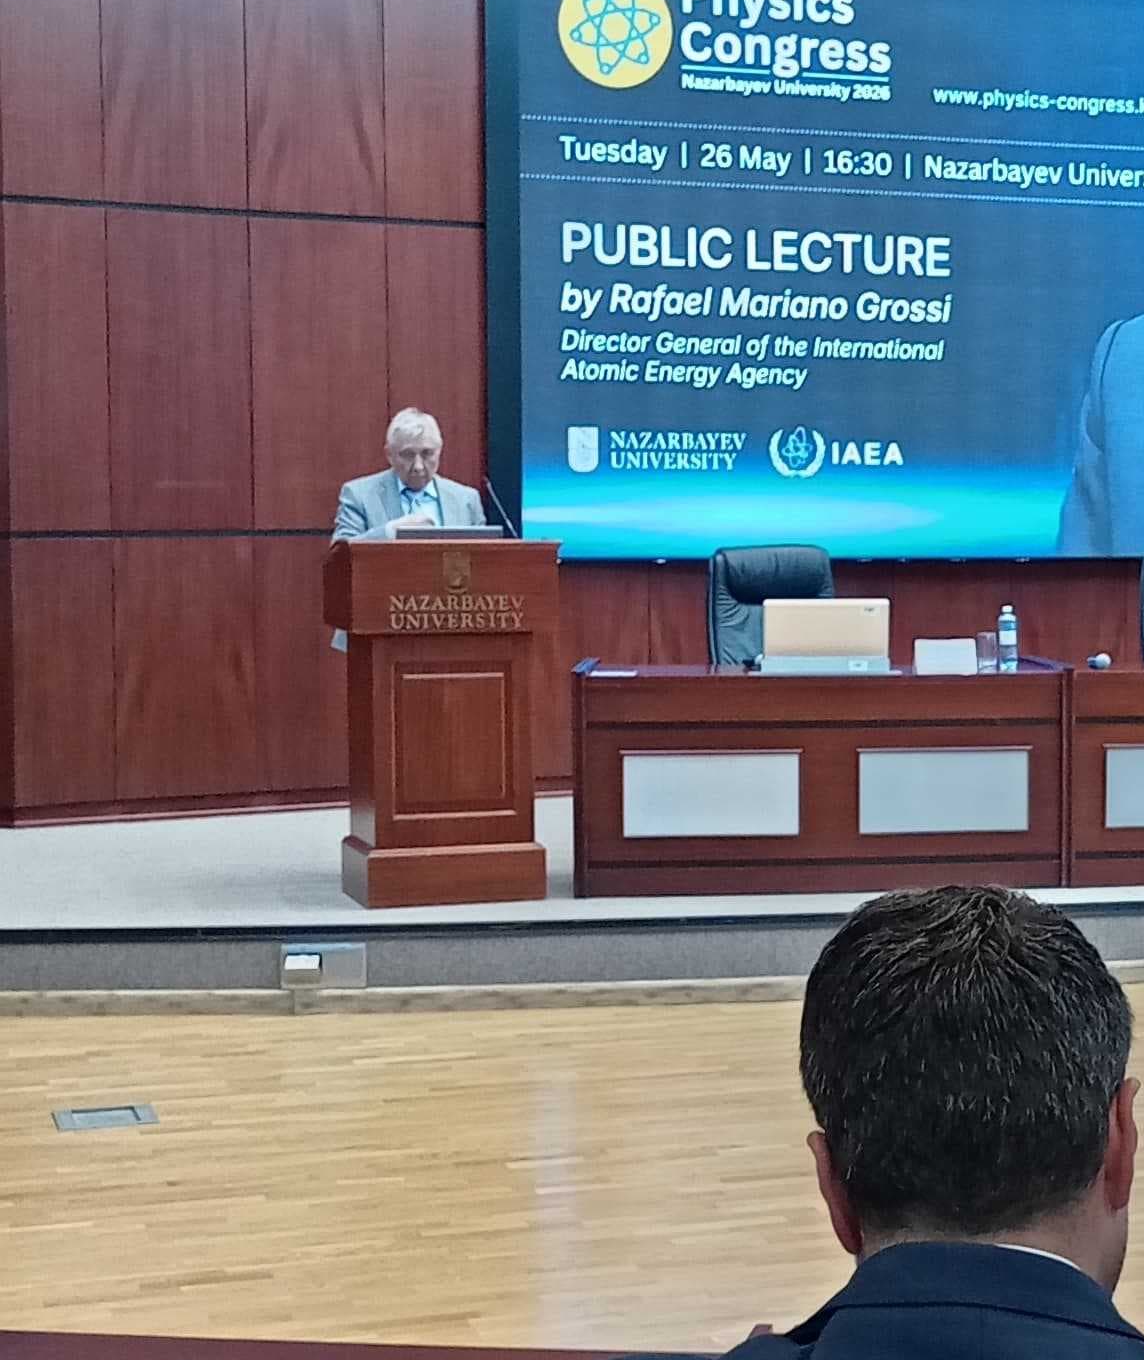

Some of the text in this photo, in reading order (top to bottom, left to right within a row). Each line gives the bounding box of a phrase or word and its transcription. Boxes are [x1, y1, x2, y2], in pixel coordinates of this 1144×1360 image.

[680, 21, 892, 78] Congress
[681, 73, 892, 101] Nazarbayev University 2026
[559, 136, 668, 171] Tuesday
[700, 143, 733, 168] 26
[739, 145, 792, 176] May
[823, 149, 893, 176] 16:30
[924, 154, 1062, 189] Nazarbayev
[562, 221, 951, 277] PUBLIC LECTURE
[561, 281, 952, 324] by Rafael Mariano Grossi
[561, 329, 944, 361] Director General of the International
[561, 358, 807, 390] Atomic Energy Agency
[610, 430, 746, 450] NAZARBAYEV
[831, 441, 904, 466] IAEA
[610, 451, 737, 471] UNIVERSITY
[389, 595, 525, 612] NAZARBAYEV
[391, 612, 524, 630] UNIVERSITY
